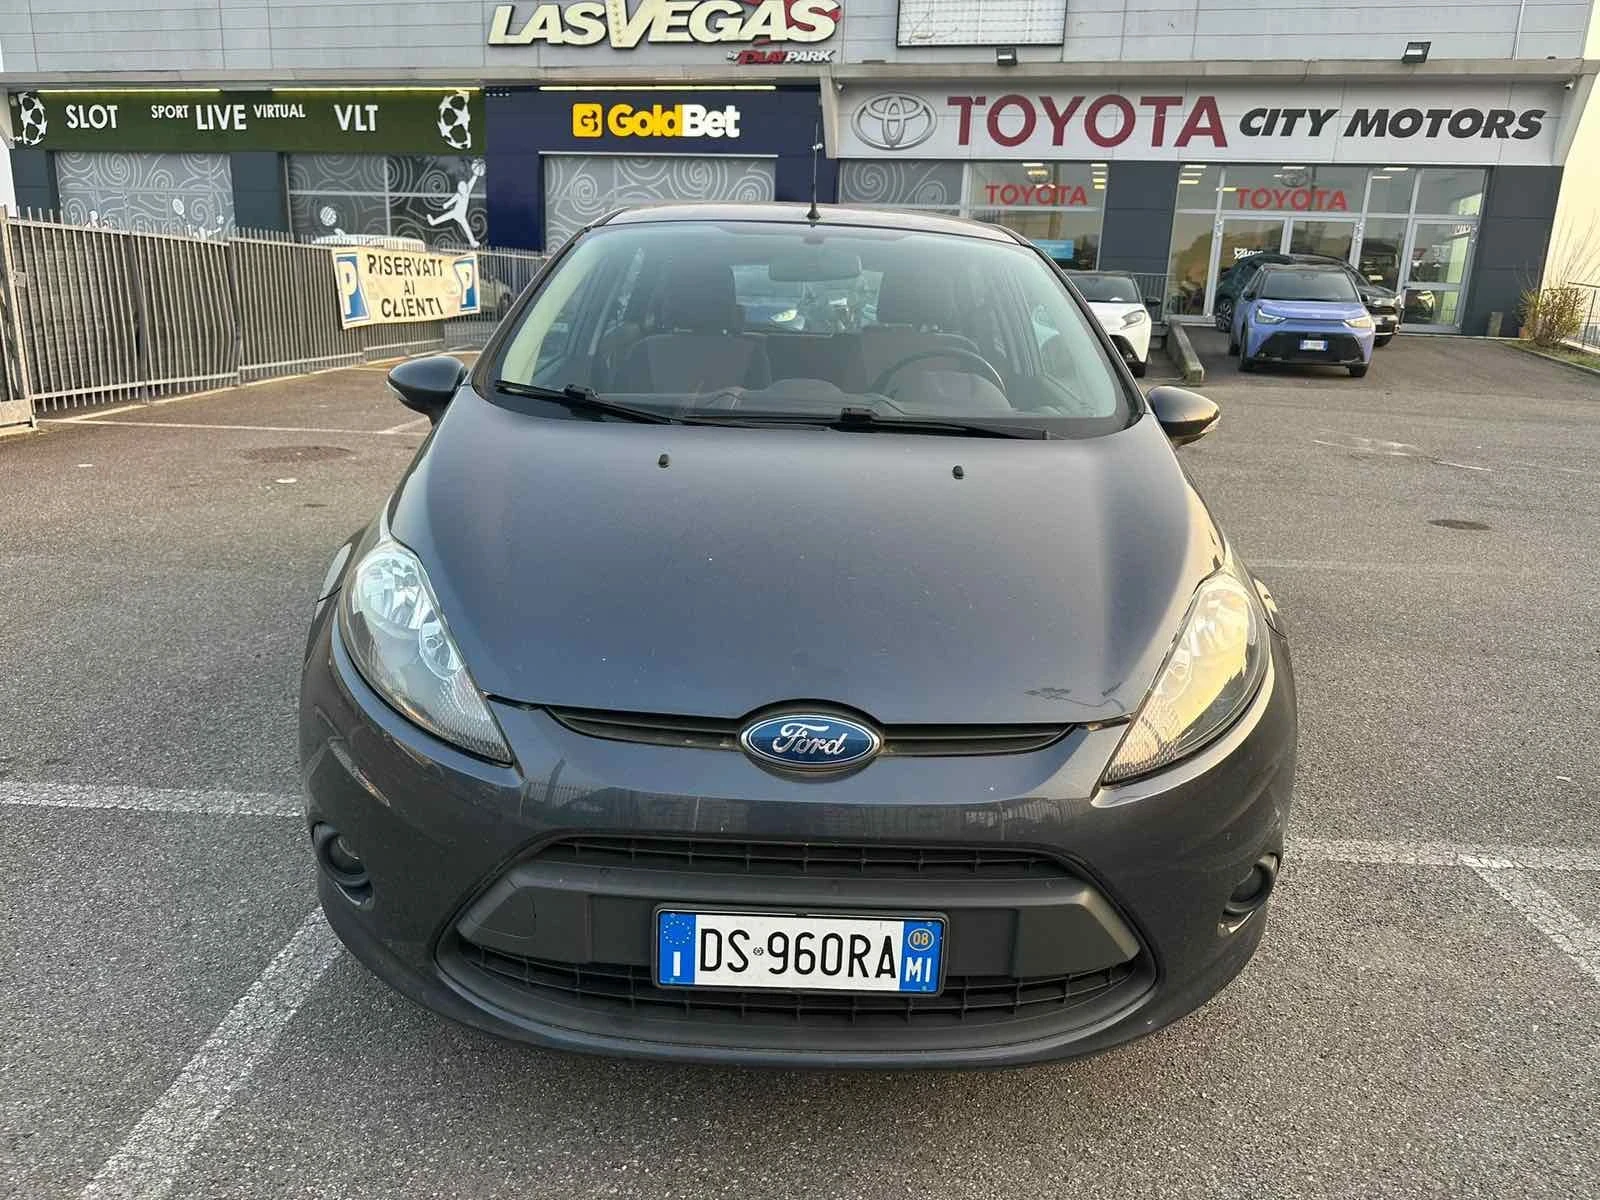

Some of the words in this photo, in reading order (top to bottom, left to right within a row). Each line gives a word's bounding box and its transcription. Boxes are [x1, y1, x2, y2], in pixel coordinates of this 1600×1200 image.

[65, 104, 118, 130] SLOT
[151, 104, 189, 120] SPORT
[195, 104, 247, 131] LIVE
[253, 104, 306, 119] VIRTUAL
[334, 104, 378, 132] VLT
[607, 104, 740, 138] GoldBet
[948, 94, 1228, 148] TOYOTA
[1239, 107, 1339, 137] CITY
[1344, 108, 1546, 140] MOTORS
[985, 184, 1088, 206] TOYOTA
[1235, 187, 1349, 212] TOYOTA
[366, 253, 443, 278] RISERVATI
[404, 279, 416, 296] AI
[381, 297, 444, 318] CLIENTI
[772, 722, 849, 755] Ford
[911, 931, 930, 947] 08
[905, 956, 932, 983] MI
